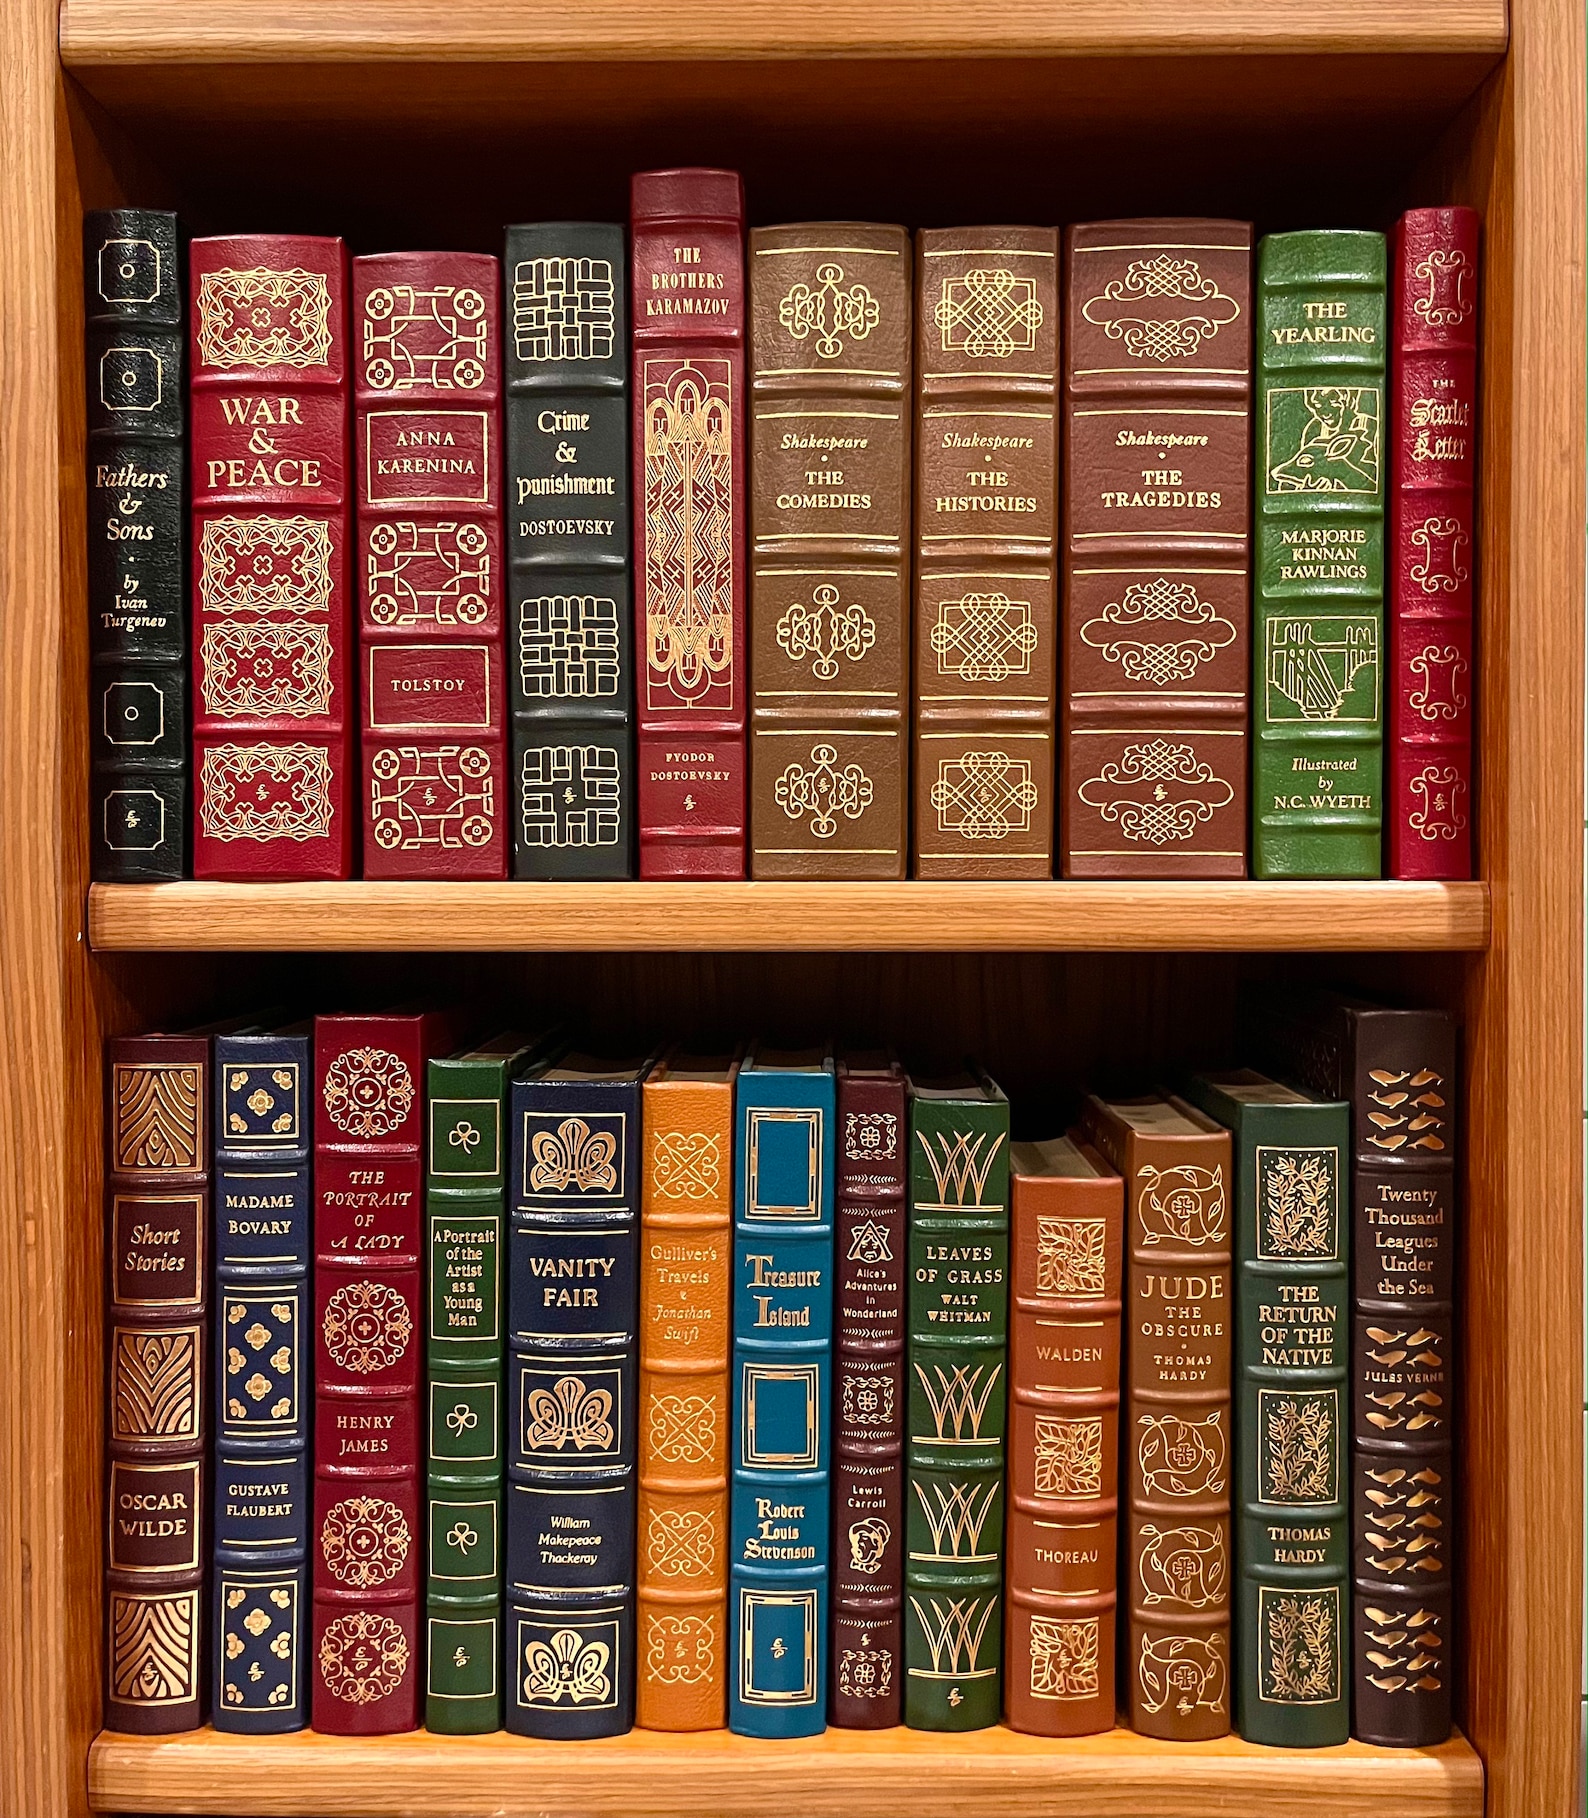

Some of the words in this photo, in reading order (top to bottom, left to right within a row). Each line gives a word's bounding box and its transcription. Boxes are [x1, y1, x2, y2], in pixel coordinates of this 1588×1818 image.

[674, 247, 701, 264] THE
[651, 272, 724, 290] BROTHERS
[646, 298, 729, 316] KARAMAZOV
[1302, 302, 1348, 319] THE
[1271, 326, 1376, 345] YEARLING
[220, 397, 303, 426] WAR
[537, 410, 590, 435] Crime
[248, 427, 278, 455] &
[396, 431, 456, 446] ANNA
[780, 433, 868, 450] Shakespeare
[941, 432, 1033, 450] Shakespeare
[1115, 430, 1209, 448] Shakespeare
[1411, 429, 1466, 462] Letter
[555, 441, 578, 463] &
[207, 459, 322, 488] PEACE
[377, 459, 476, 475] KARENINA
[95, 463, 168, 489] Fathers
[805, 471, 844, 486] THE
[966, 472, 1009, 487] THE
[1141, 470, 1182, 485] THE
[119, 492, 142, 514] &
[776, 494, 872, 510] COMEDIES
[935, 496, 1037, 513] HISTORIES
[1101, 491, 1222, 508] TRAGEDIES
[107, 518, 154, 541] Sons
[520, 520, 615, 536] DOSTOEVSKY
[1282, 529, 1367, 546] MARJORIE
[1292, 547, 1358, 560] KINNAN
[1280, 565, 1367, 579] RAWLINGS
[123, 574, 140, 594] by
[114, 594, 148, 609] Ivan
[101, 613, 167, 632] Turgenev
[391, 679, 466, 692] TOLSTOY
[665, 753, 715, 762] FYODOR
[1292, 757, 1358, 771] Illustrated
[650, 771, 730, 781] DOSTOEVSKY
[1318, 775, 1334, 791] by
[1310, 795, 1371, 809] WYETH
[349, 1171, 385, 1185] THE
[225, 1194, 294, 1208] MADAME
[323, 1191, 412, 1208] PORTRAIT
[1377, 1184, 1438, 1208] Twenty
[354, 1214, 375, 1227] OF
[1364, 1207, 1444, 1225] Thousand
[131, 1223, 181, 1244] Short
[228, 1220, 292, 1235] BOVARY
[331, 1236, 348, 1249] A
[354, 1235, 405, 1250] LADY
[434, 1230, 442, 1243] A
[443, 1229, 495, 1243] Portrait
[1375, 1231, 1438, 1254] Leagues
[445, 1247, 460, 1260] of
[461, 1247, 483, 1260] the
[650, 1245, 717, 1261] Gulliver's
[926, 1246, 992, 1261] LEAVES
[125, 1251, 186, 1272] Stories
[529, 1257, 616, 1277] VANITY
[1381, 1255, 1434, 1272] Under
[445, 1263, 483, 1277] Artist
[656, 1268, 710, 1284] Travels
[745, 1254, 821, 1288] Treasure
[856, 1268, 886, 1278] Alice's
[916, 1268, 938, 1283] OF
[947, 1269, 1003, 1284] GRASS
[452, 1281, 466, 1293] as
[467, 1281, 476, 1293] a
[845, 1280, 897, 1291] Adventures
[1140, 1275, 1224, 1300] JUDE
[1377, 1278, 1405, 1295] the
[1409, 1278, 1434, 1295] Sea
[543, 1288, 599, 1307] FAIR
[941, 1294, 978, 1305] WALT
[1278, 1286, 1320, 1303] THE
[443, 1295, 483, 1313] Young
[753, 1295, 810, 1327] Island
[448, 1313, 478, 1326] Man
[653, 1304, 711, 1321] Jonathan
[843, 1308, 898, 1319] Wonderland
[927, 1310, 991, 1322] WHITMAN
[1165, 1306, 1202, 1319] THE
[1258, 1305, 1337, 1323] RETURN
[664, 1326, 699, 1345] Swift
[1141, 1322, 1223, 1337] OBSCURE
[1261, 1327, 1288, 1344] OF
[1293, 1327, 1334, 1344] THE
[1036, 1346, 1102, 1361] WALDEN
[1153, 1355, 1212, 1366] THOMAS
[1262, 1347, 1333, 1366] NATIVE
[1159, 1370, 1207, 1381] HARDY
[1364, 1371, 1403, 1383] JULES
[337, 1415, 395, 1429] HENRY
[339, 1439, 388, 1456] JAMES
[228, 1483, 289, 1497] GUSTAVE
[852, 1485, 882, 1495] Lewis
[119, 1492, 188, 1511] OSCAR
[755, 1497, 805, 1519] Robert
[848, 1498, 886, 1508] Carroll
[226, 1503, 292, 1517] FLAUBERT
[119, 1518, 187, 1537] WILDE
[550, 1515, 591, 1529] William
[757, 1520, 799, 1540] Louis
[538, 1533, 602, 1548] Makepeace
[1267, 1526, 1331, 1542] THOMAS
[744, 1538, 815, 1559] Stevenson
[1034, 1548, 1098, 1564] THOREAU
[1274, 1548, 1326, 1563] HARDY
[540, 1551, 598, 1565] Thackeray
